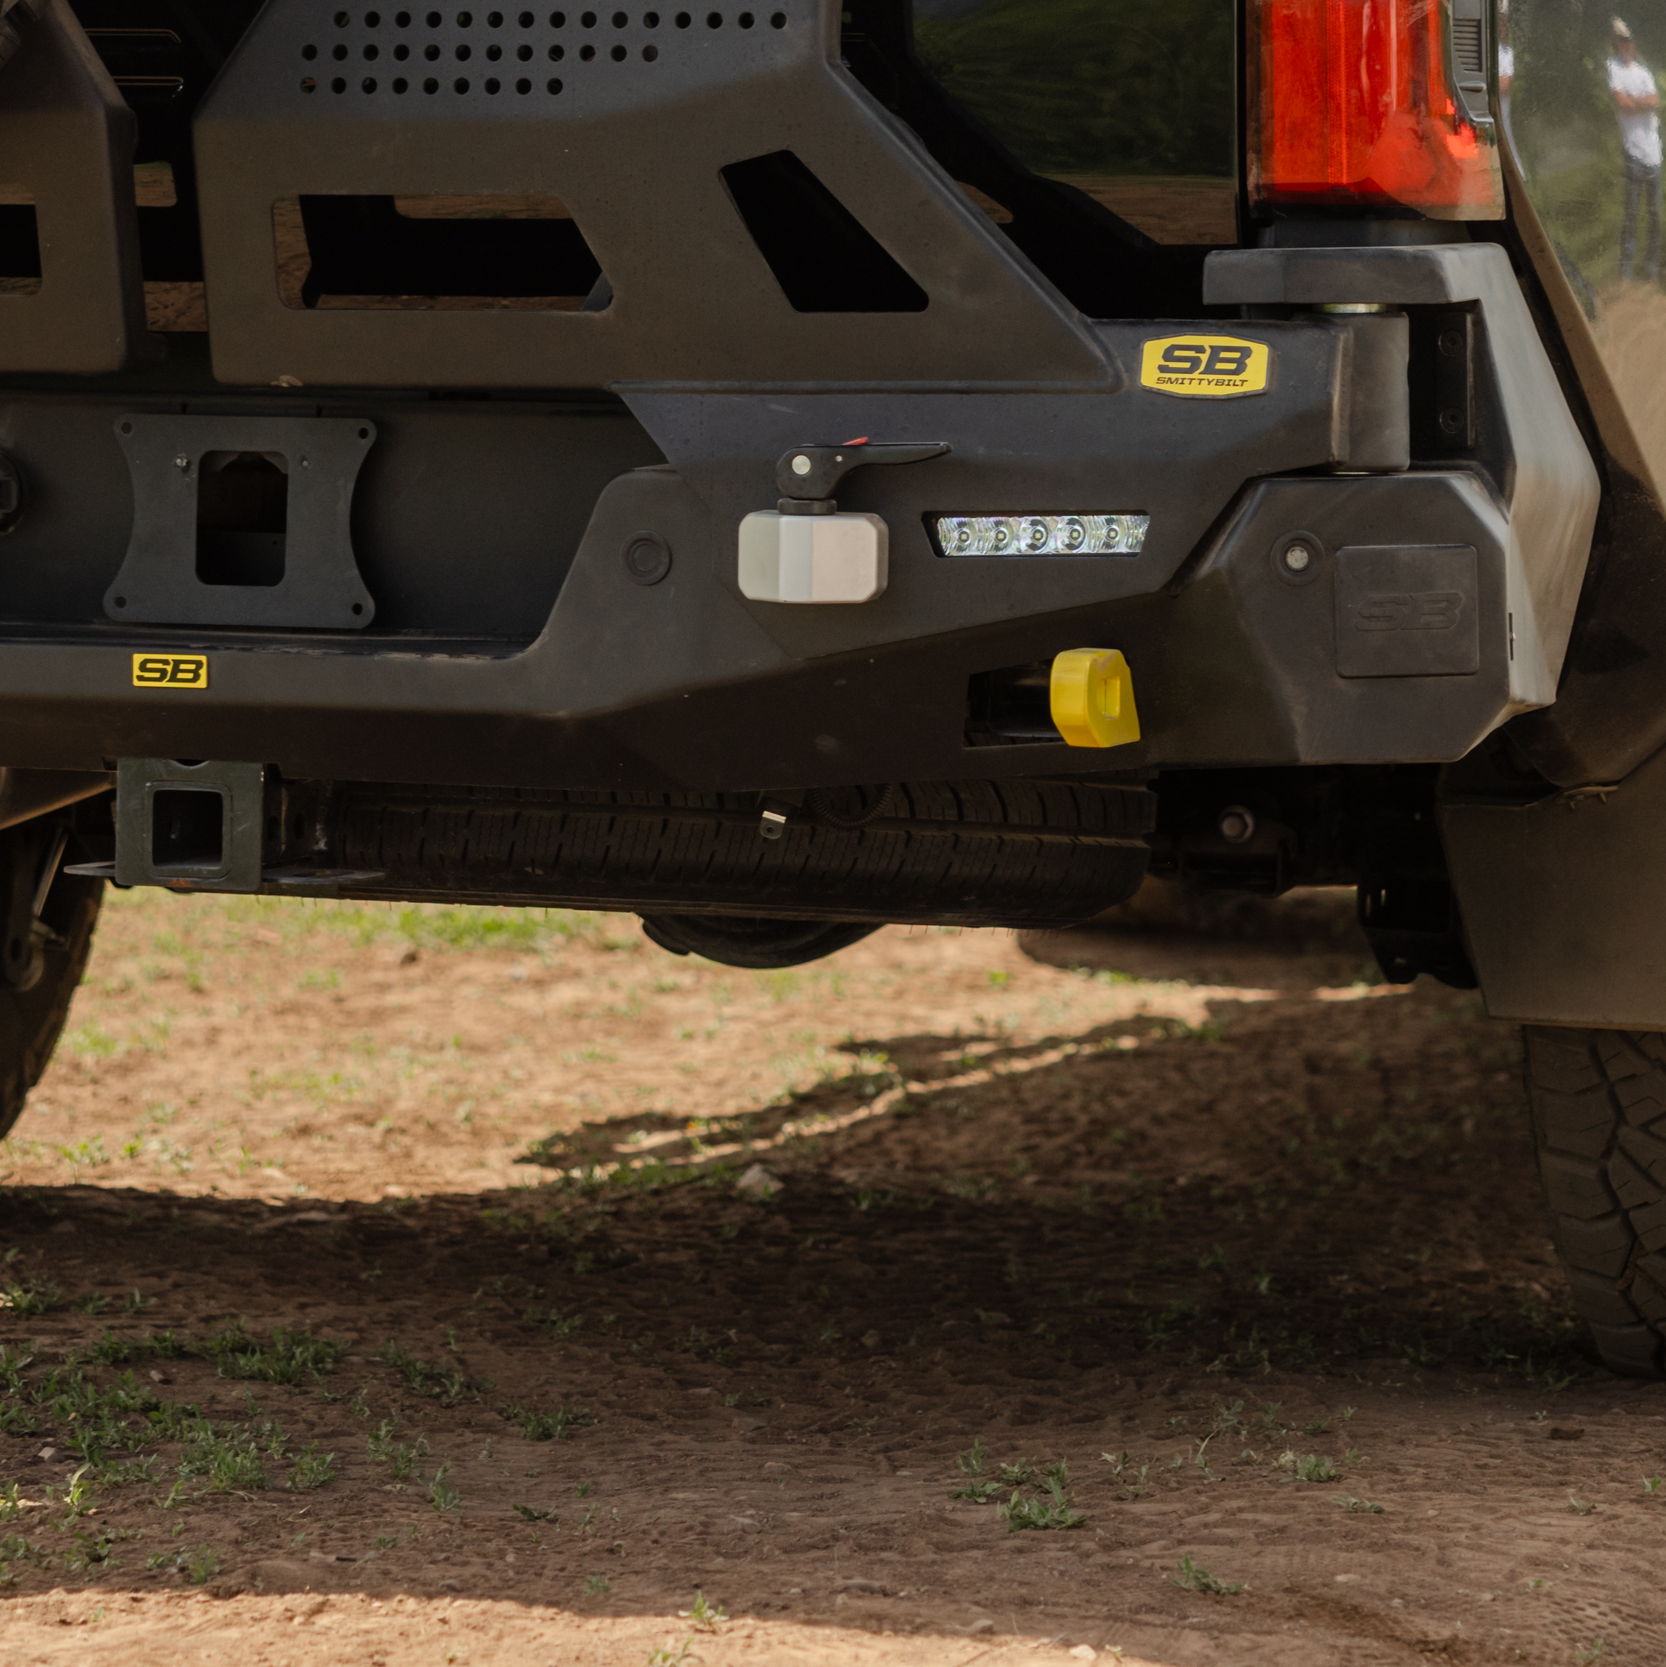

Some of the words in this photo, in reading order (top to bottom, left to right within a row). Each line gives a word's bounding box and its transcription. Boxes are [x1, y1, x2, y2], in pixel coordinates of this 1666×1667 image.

[1157, 343, 1254, 376] SB
[1156, 376, 1249, 388] SMITTYBILT
[1354, 591, 1464, 631] SB
[135, 658, 204, 683] SB
